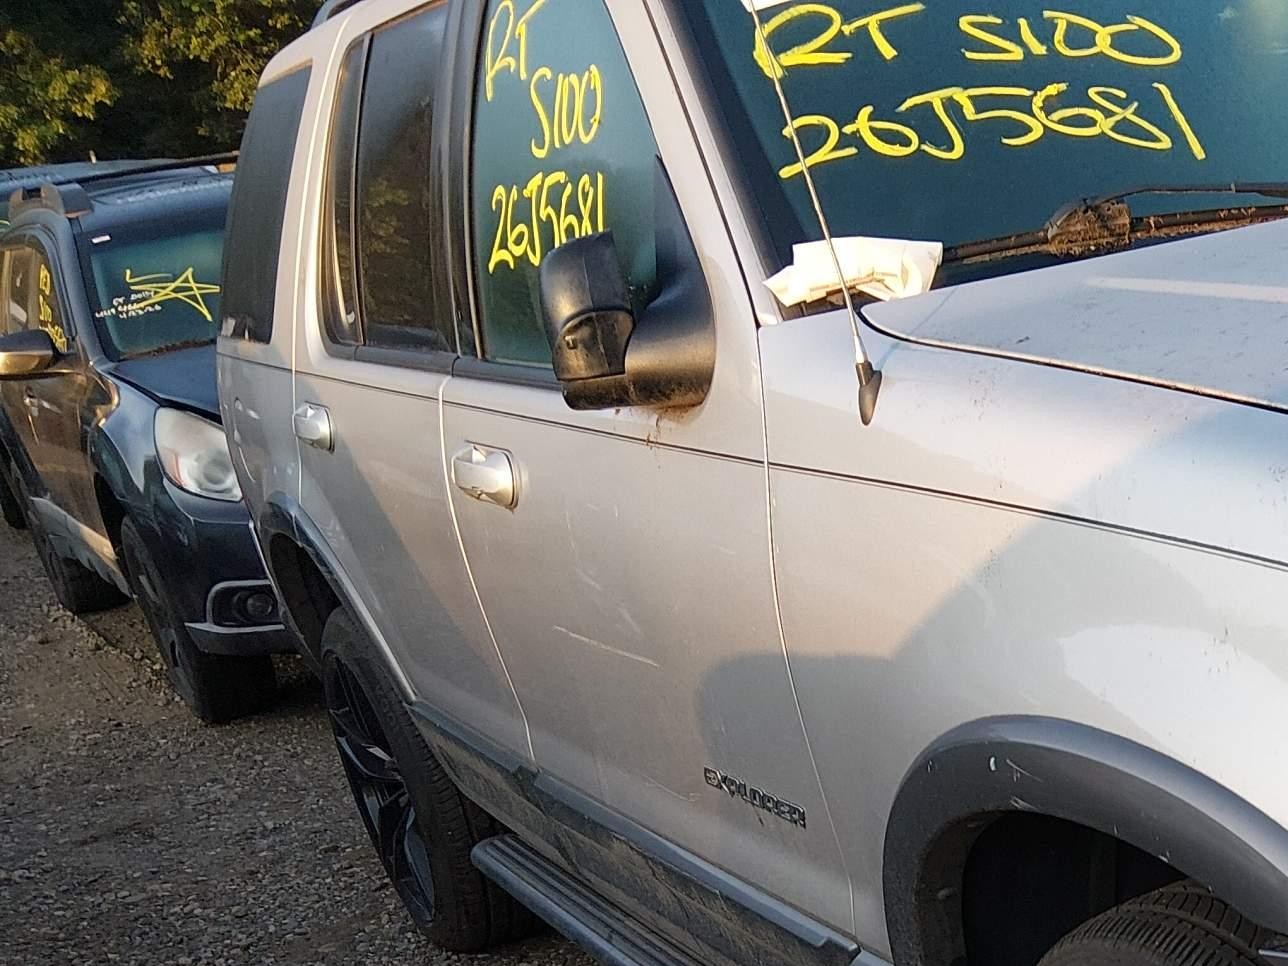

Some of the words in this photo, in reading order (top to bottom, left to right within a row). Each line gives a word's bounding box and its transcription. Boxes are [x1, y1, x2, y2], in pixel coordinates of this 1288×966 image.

[485, 0, 546, 102] RT
[752, 3, 926, 80] RT
[530, 64, 603, 158] S100
[779, 82, 1206, 179] 26J5681
[703, 765, 806, 829] EXPLORER
